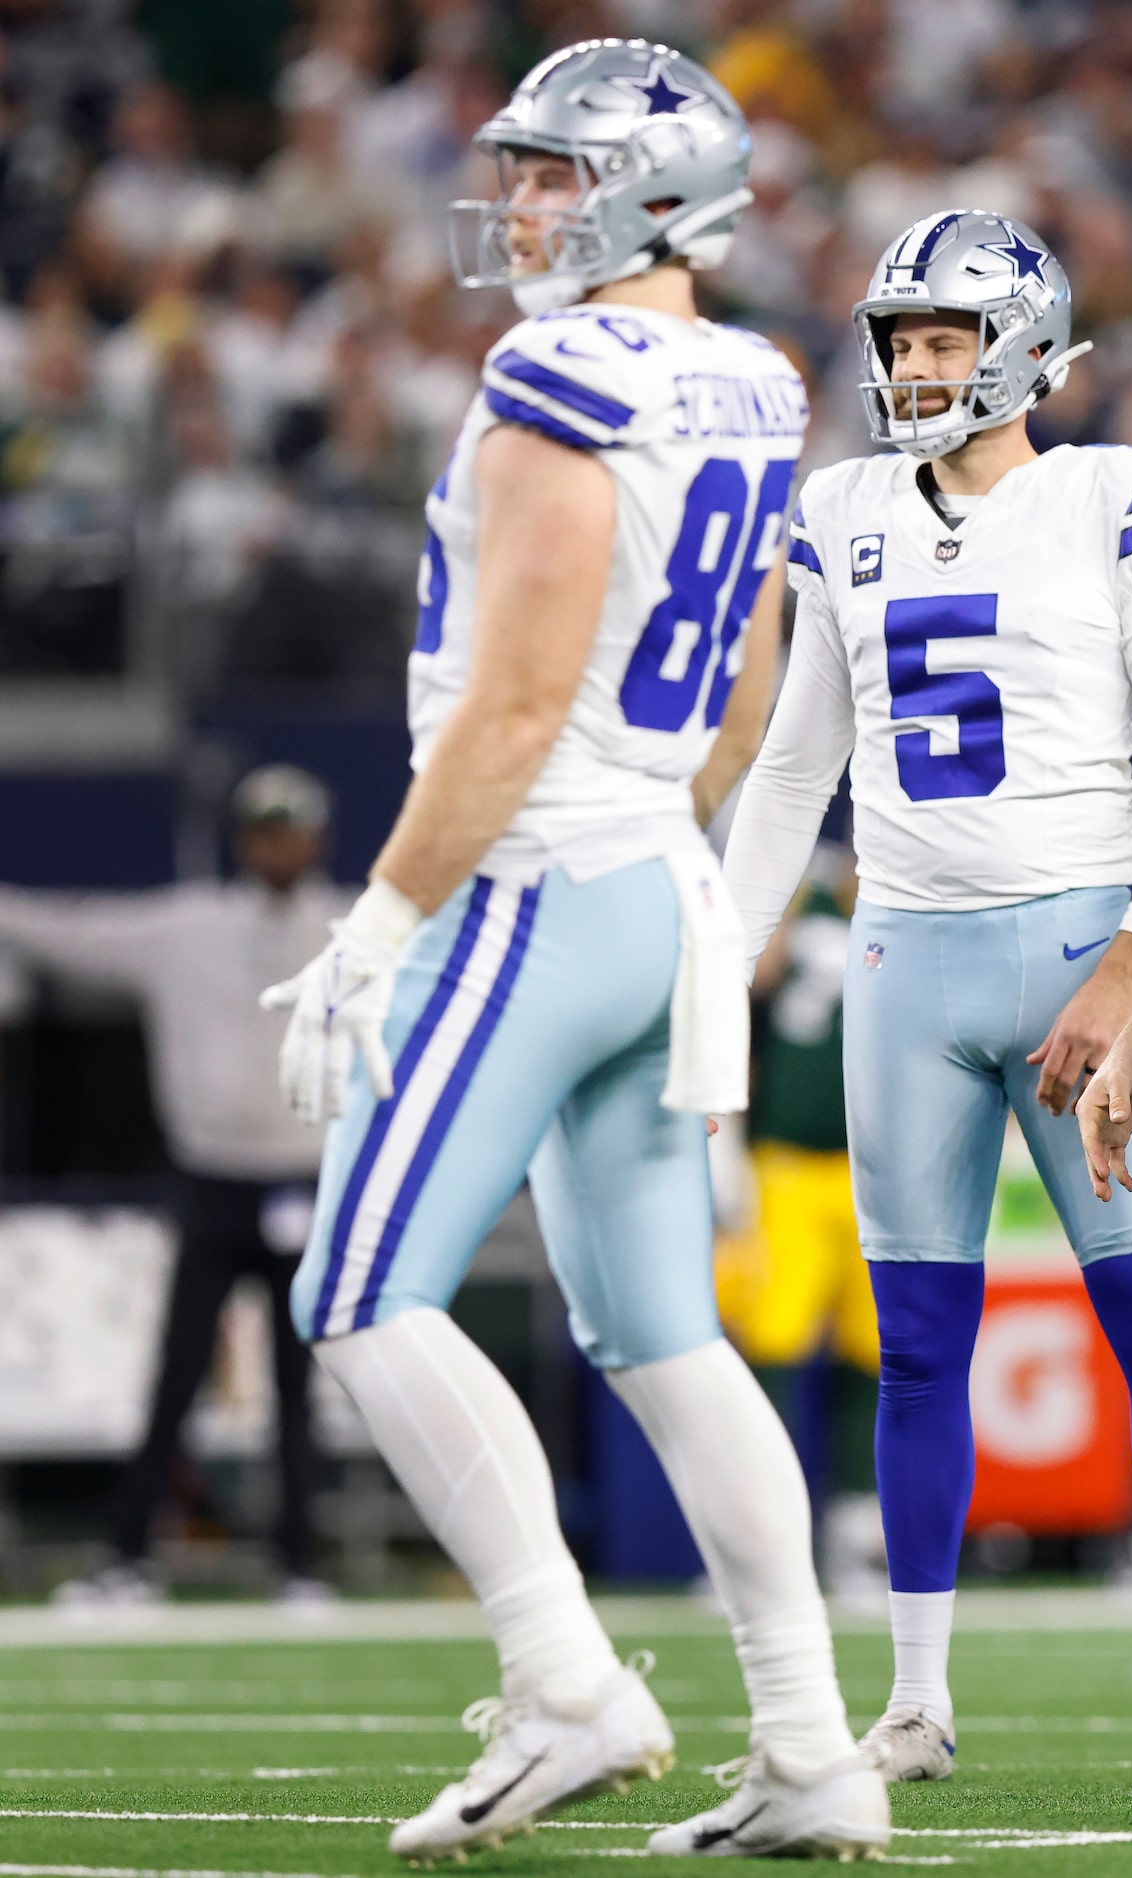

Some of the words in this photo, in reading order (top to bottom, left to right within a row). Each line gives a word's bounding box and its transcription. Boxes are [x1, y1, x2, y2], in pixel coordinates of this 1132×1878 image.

[851, 536, 881, 574] C
[885, 592, 1007, 803] 5
[968, 1303, 1096, 1468] G
